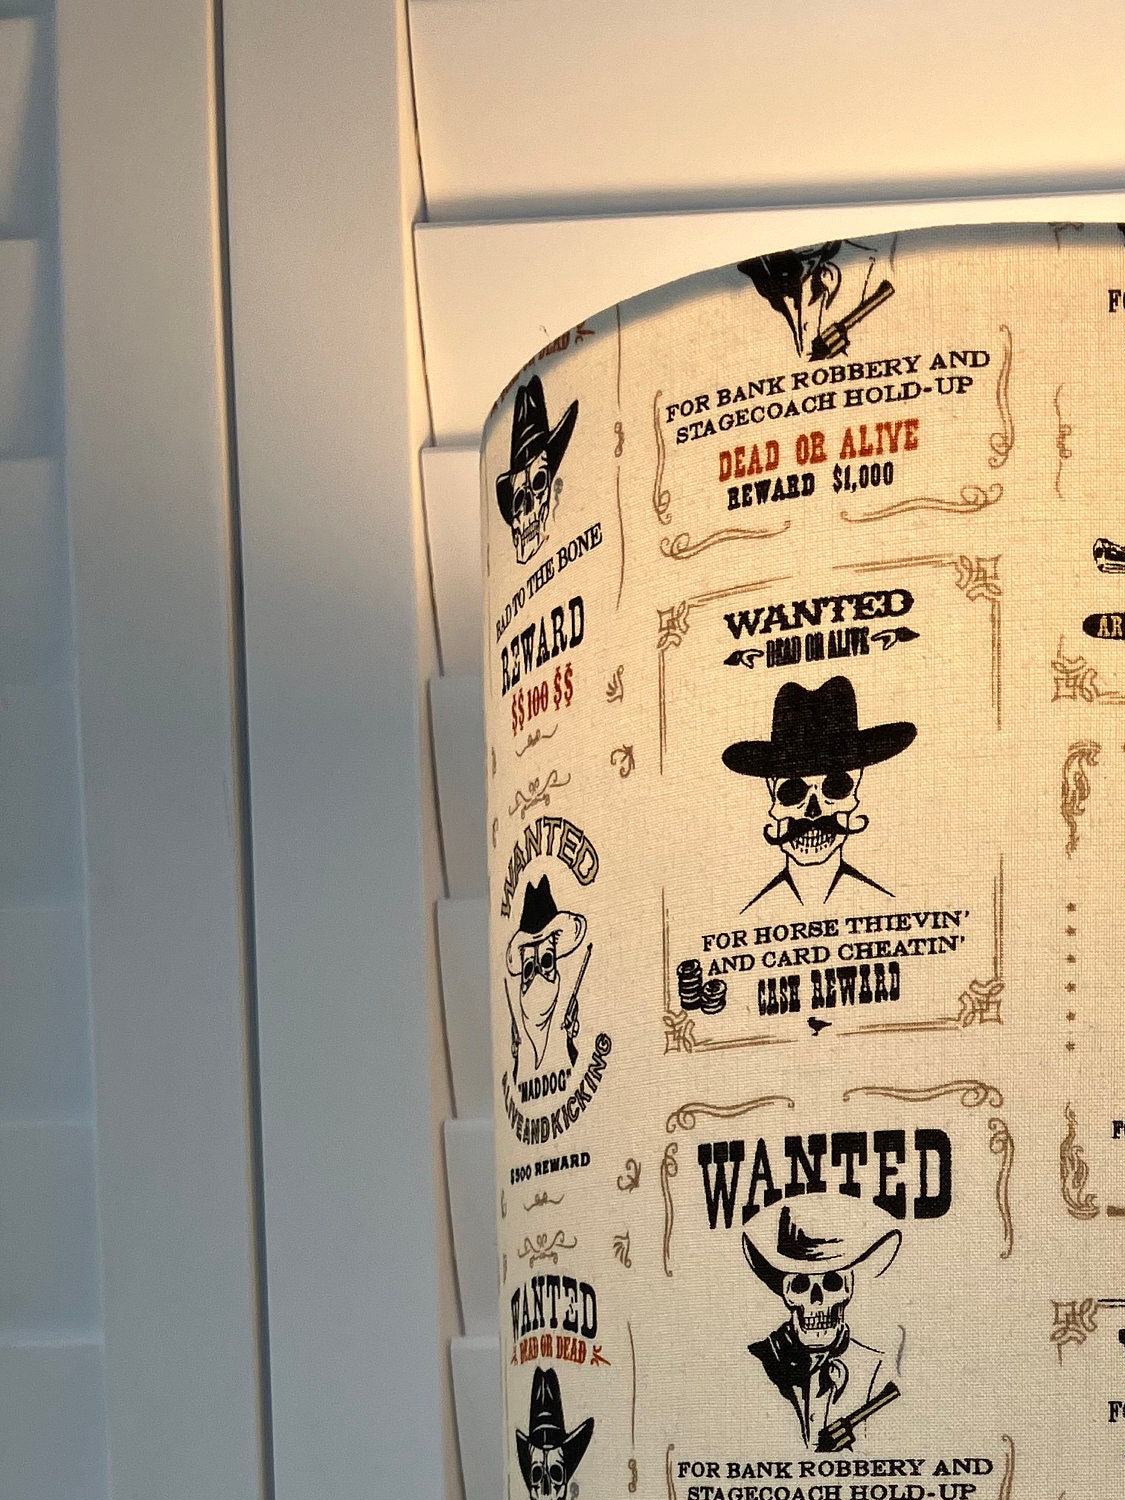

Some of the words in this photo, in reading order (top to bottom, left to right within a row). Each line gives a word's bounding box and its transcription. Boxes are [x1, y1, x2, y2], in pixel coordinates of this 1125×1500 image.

[665, 393, 709, 423] FOR
[716, 375, 787, 411] BANK
[791, 355, 923, 393] ROBBERY
[929, 349, 991, 373] AND
[676, 393, 838, 445] STAGECOACH
[843, 375, 975, 406] HOLD-UP
[718, 438, 781, 482] DEAD
[795, 430, 827, 463] OR
[840, 418, 919, 460] ALIVE
[726, 473, 815, 511] REWARD
[832, 461, 895, 495] $1,000
[496, 604, 512, 643] BAD
[512, 588, 526, 616] TO
[527, 558, 554, 599] THE
[556, 522, 603, 573] BONE
[723, 588, 915, 640] WANTED
[501, 595, 584, 697] REWARD
[766, 633, 801, 669] DEAD
[805, 631, 825, 662] OR
[827, 626, 870, 659] ALIVE
[500, 815, 600, 919] WANTED
[702, 930, 748, 952] FOR
[753, 918, 840, 945] HORSE
[845, 909, 971, 937] THIEVIN'
[707, 954, 755, 976] AND
[762, 946, 830, 969] CARD
[838, 936, 966, 962] CHEATIN'
[757, 976, 801, 1016] CASH
[811, 961, 901, 1010] REWARD
[534, 1152, 590, 1176] REWARD
[697, 1127, 953, 1230] WANTED
[511, 1274, 598, 1344] WANTED
[519, 1339, 539, 1365] DEAD
[540, 1333, 553, 1358] OR
[556, 1335, 588, 1365] DEAD
[677, 1460, 720, 1480] FOR
[727, 1460, 792, 1480] BANK
[799, 1458, 926, 1478] ROBBERY
[932, 1458, 995, 1477] AND
